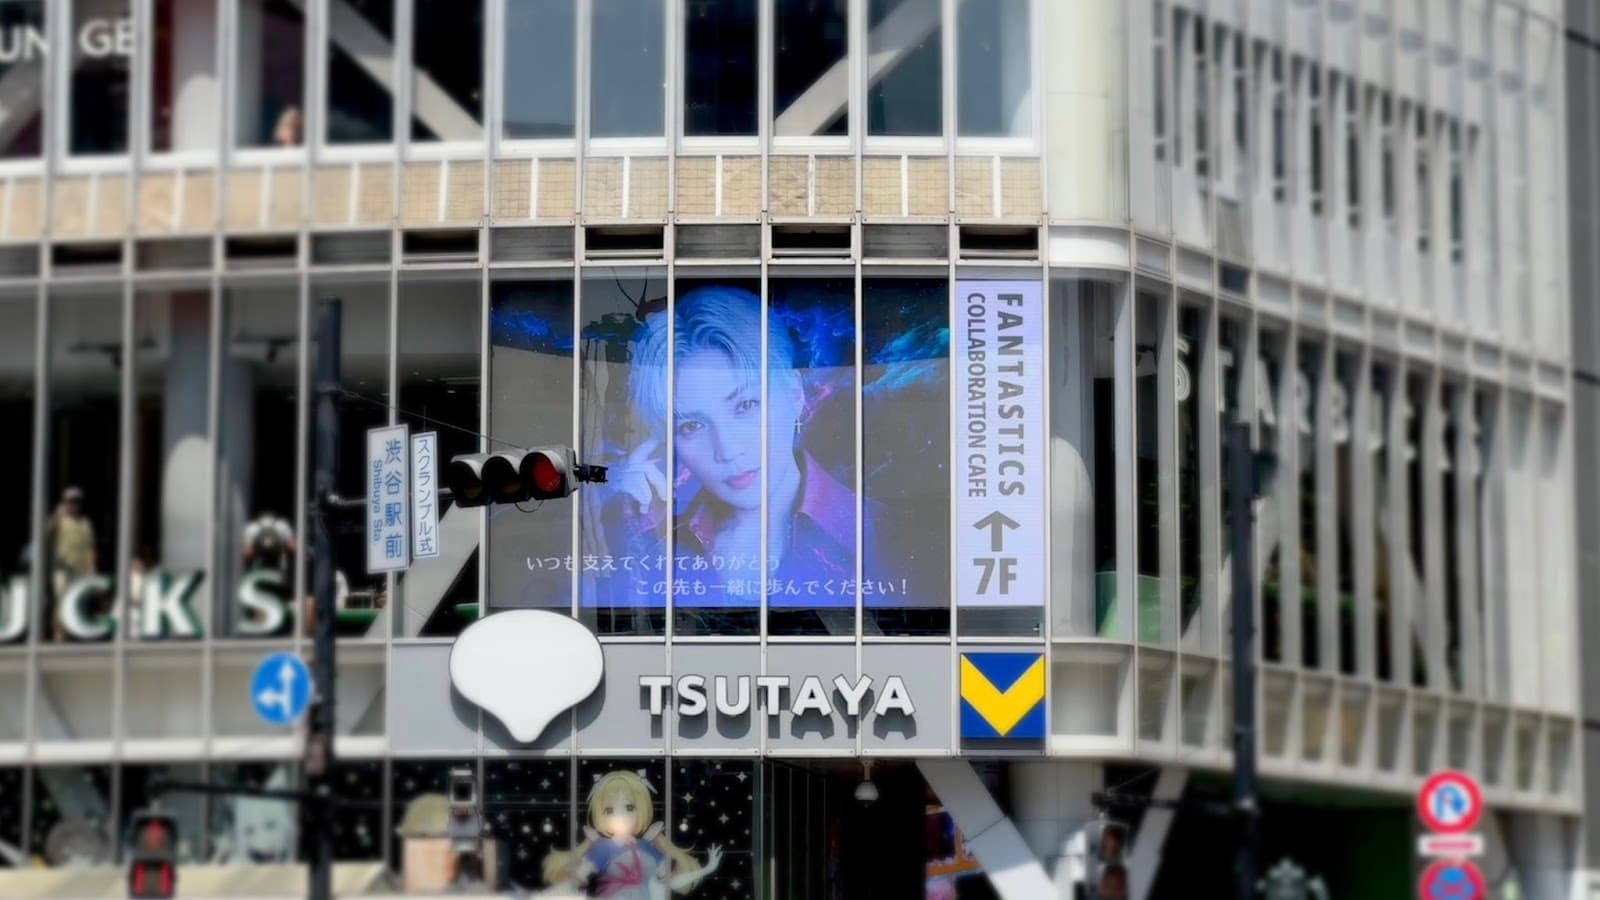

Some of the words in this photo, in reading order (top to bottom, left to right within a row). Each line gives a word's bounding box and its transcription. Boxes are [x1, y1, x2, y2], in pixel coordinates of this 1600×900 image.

[967, 293, 986, 449] COLLABORATION
[998, 293, 1025, 496] FANTASTICS
[373, 459, 382, 514] Shibuya
[384, 439, 402, 559] 渋谷駅前
[968, 454, 987, 497] CAFE
[973, 558, 1018, 595] 7F
[639, 674, 916, 717] TSUTAYA
